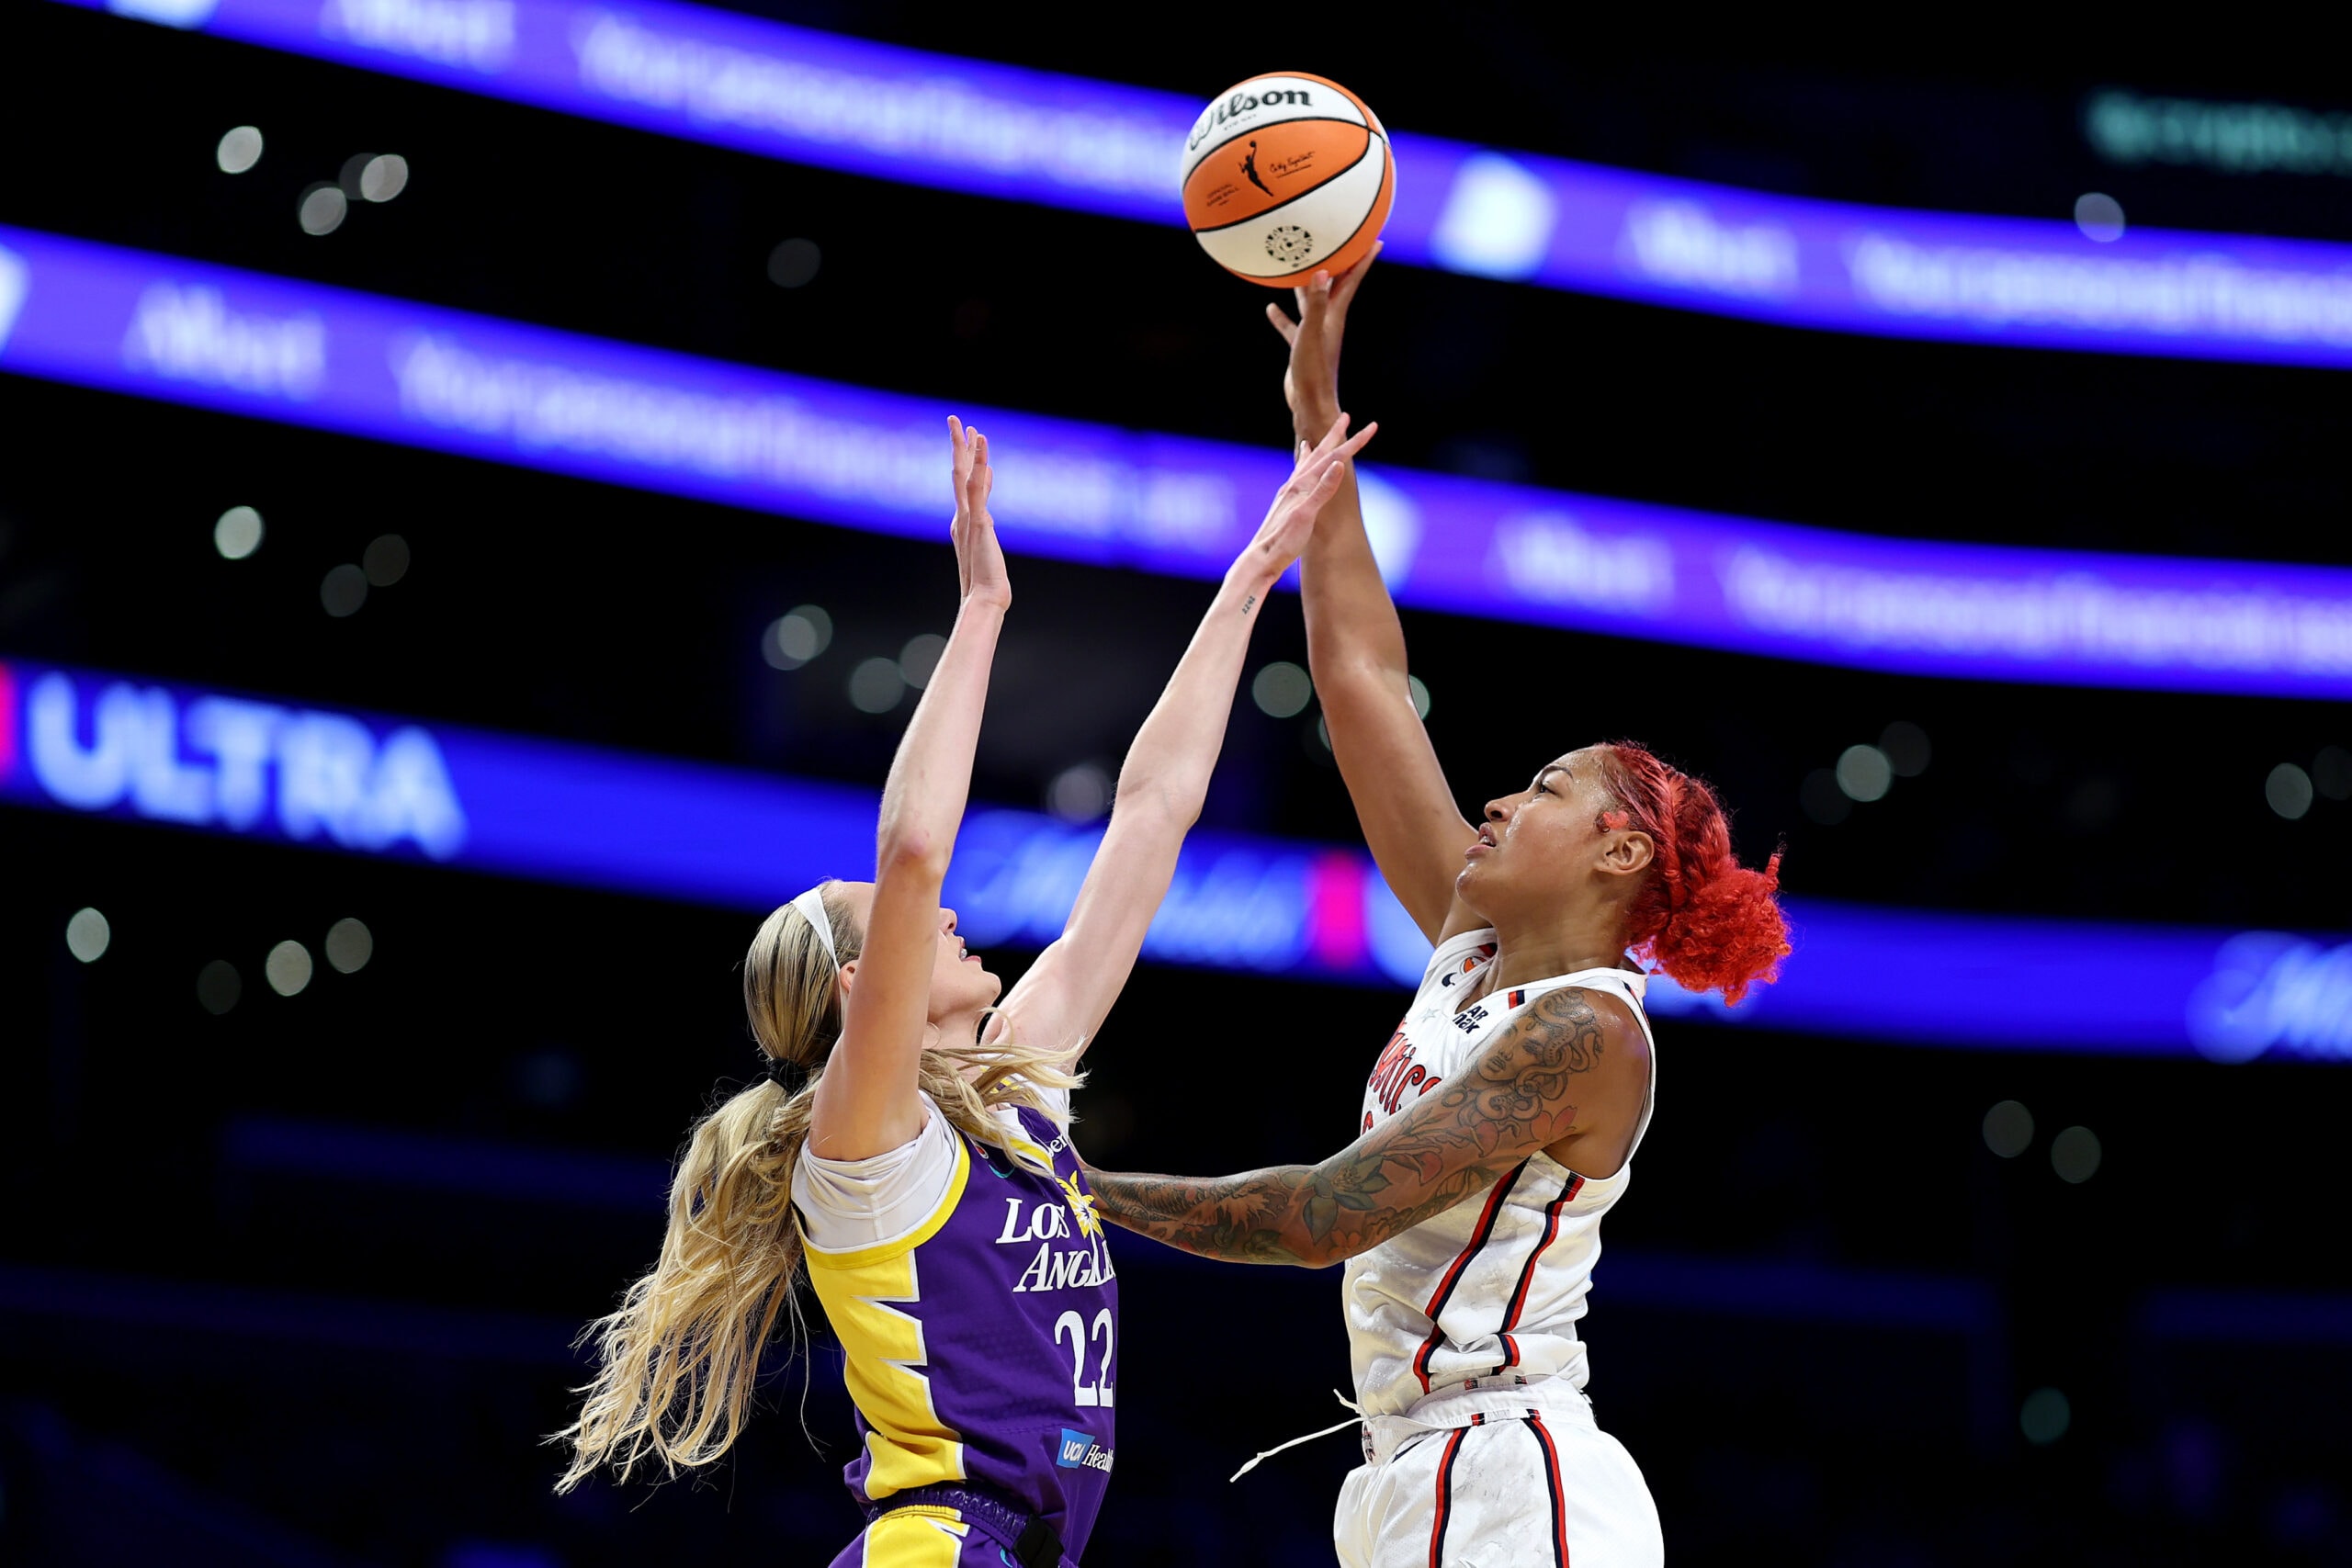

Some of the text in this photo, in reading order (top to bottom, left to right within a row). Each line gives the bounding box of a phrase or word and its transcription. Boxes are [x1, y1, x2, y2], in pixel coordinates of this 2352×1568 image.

[1190, 90, 1313, 151] Wilson
[28, 671, 469, 862] ULTRA
[1467, 1005, 1489, 1021] AR
[1054, 1308, 1114, 1408] 22
